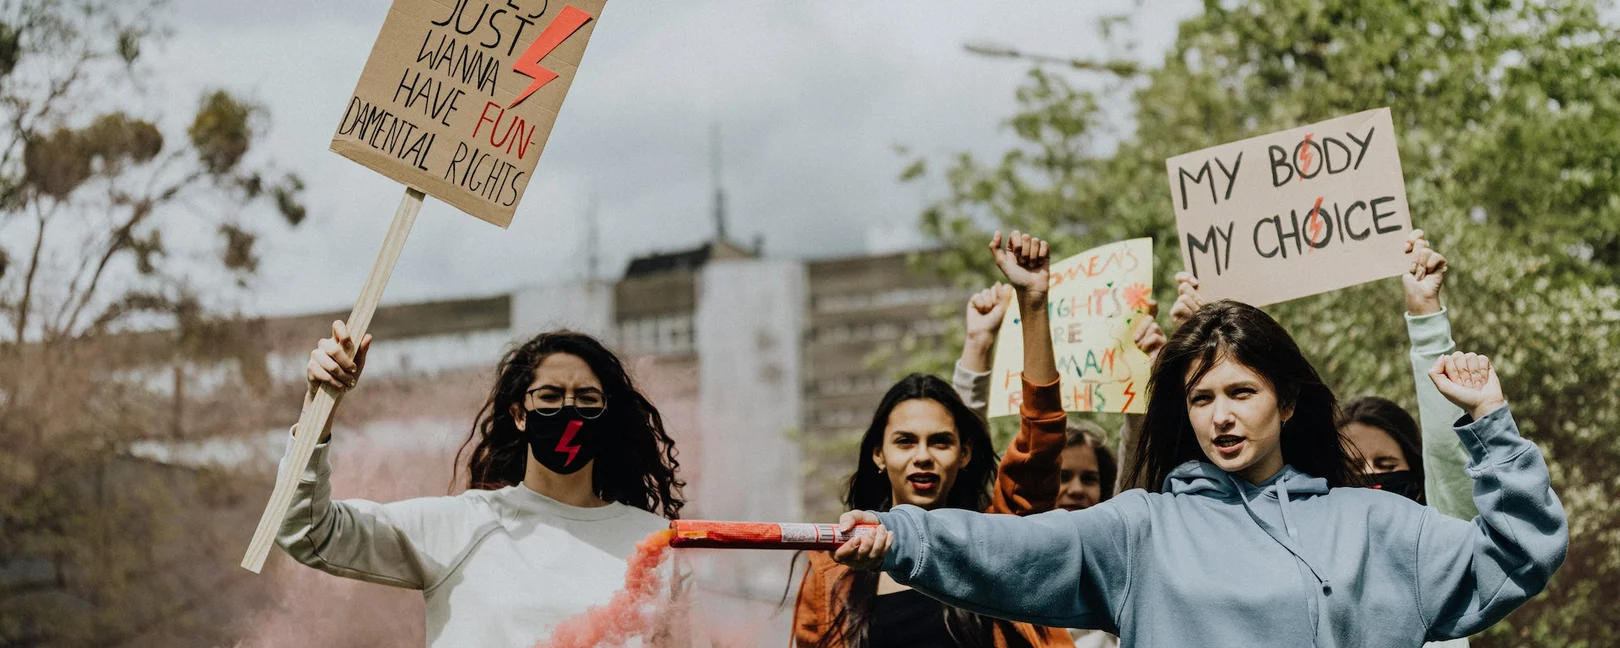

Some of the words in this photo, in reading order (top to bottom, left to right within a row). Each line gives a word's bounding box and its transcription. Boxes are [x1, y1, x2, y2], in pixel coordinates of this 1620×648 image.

[431, 0, 535, 56] JUST
[417, 30, 500, 97] WANNA
[393, 68, 465, 127] HAVE
[472, 101, 536, 160] FUN-
[339, 96, 436, 171] DAMENTAL
[444, 142, 525, 207] RIGHTS
[1179, 151, 1243, 210] MY
[1268, 127, 1375, 187] BODY
[1187, 221, 1234, 279] MY
[1253, 196, 1403, 259] CHOICE
[1048, 287, 1122, 318] IGHTS
[1053, 323, 1083, 344] RE
[1005, 347, 1132, 390] HMANS
